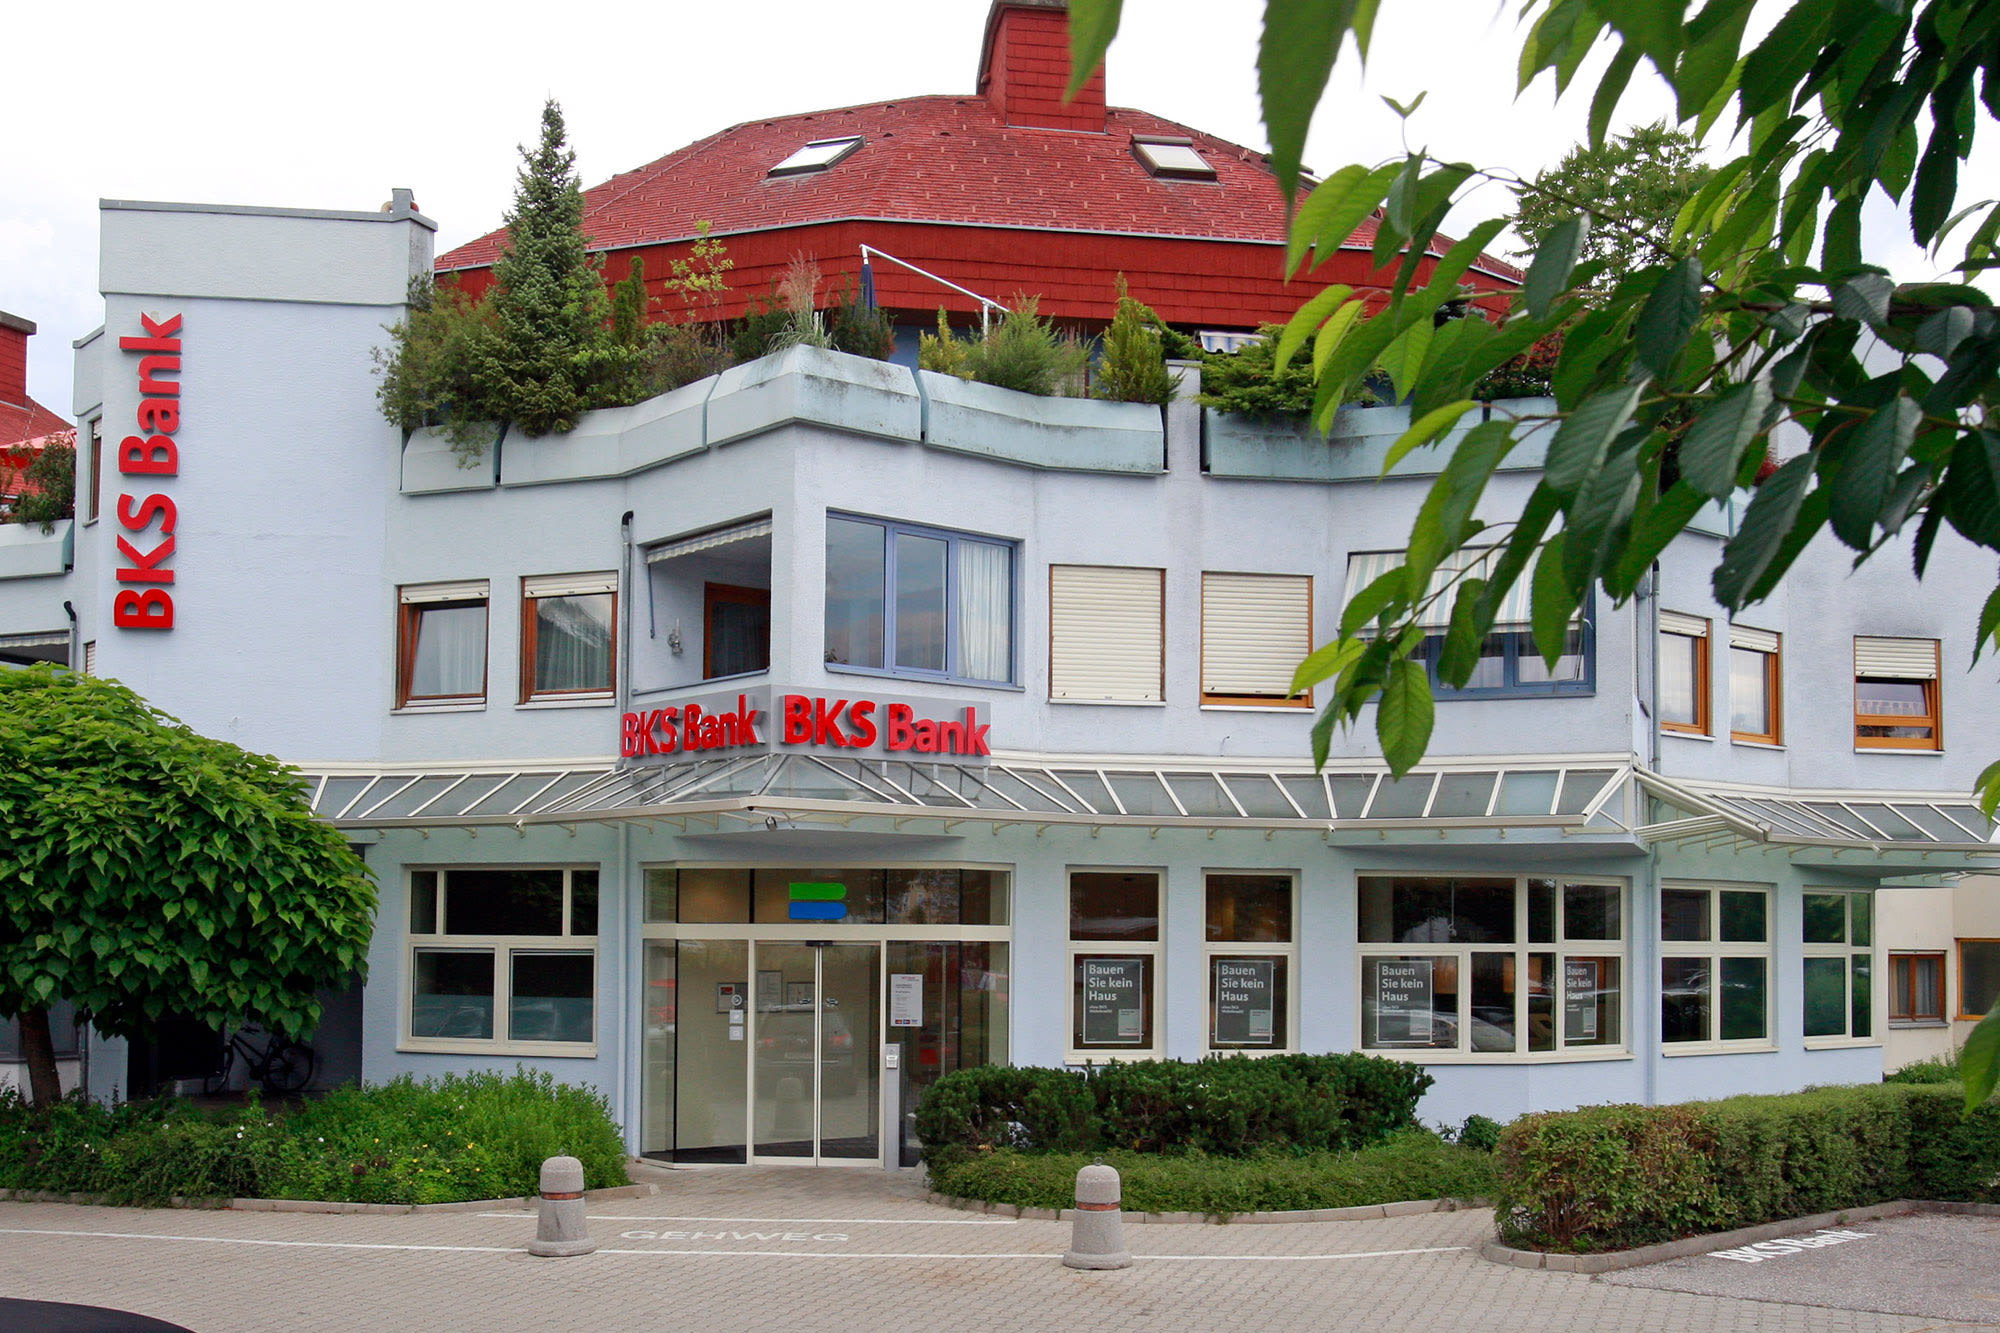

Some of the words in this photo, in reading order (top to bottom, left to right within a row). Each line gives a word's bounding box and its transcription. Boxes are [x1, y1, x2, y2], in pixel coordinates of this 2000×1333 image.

[119, 311, 182, 476] Bank
[114, 493, 177, 629] BKS
[621, 707, 678, 758] BKS
[683, 694, 759, 751] Bank
[783, 694, 877, 749] BKS
[887, 703, 991, 756] Bank
[1088, 964, 1124, 975] Bauen
[1221, 965, 1256, 975] Bauen
[1381, 965, 1415, 976] Bauen
[1566, 965, 1588, 975] Bauen
[1088, 977, 1107, 988] Sie
[1108, 977, 1133, 988] kein
[1221, 978, 1239, 989] Sie
[1240, 978, 1265, 989] kein
[1381, 978, 1399, 988] Sie
[1400, 978, 1424, 988] kein
[1566, 978, 1577, 988] Sie
[1578, 978, 1593, 988] kein
[1088, 991, 1118, 1001] Haus
[1221, 991, 1249, 1002] Haus
[1381, 991, 1409, 1001] Haus
[1566, 991, 1584, 1000] Haus
[620, 1229, 849, 1242] GEHWEG
[1706, 1242, 1803, 1263] BKS
[1770, 1229, 1877, 1249] Bank
